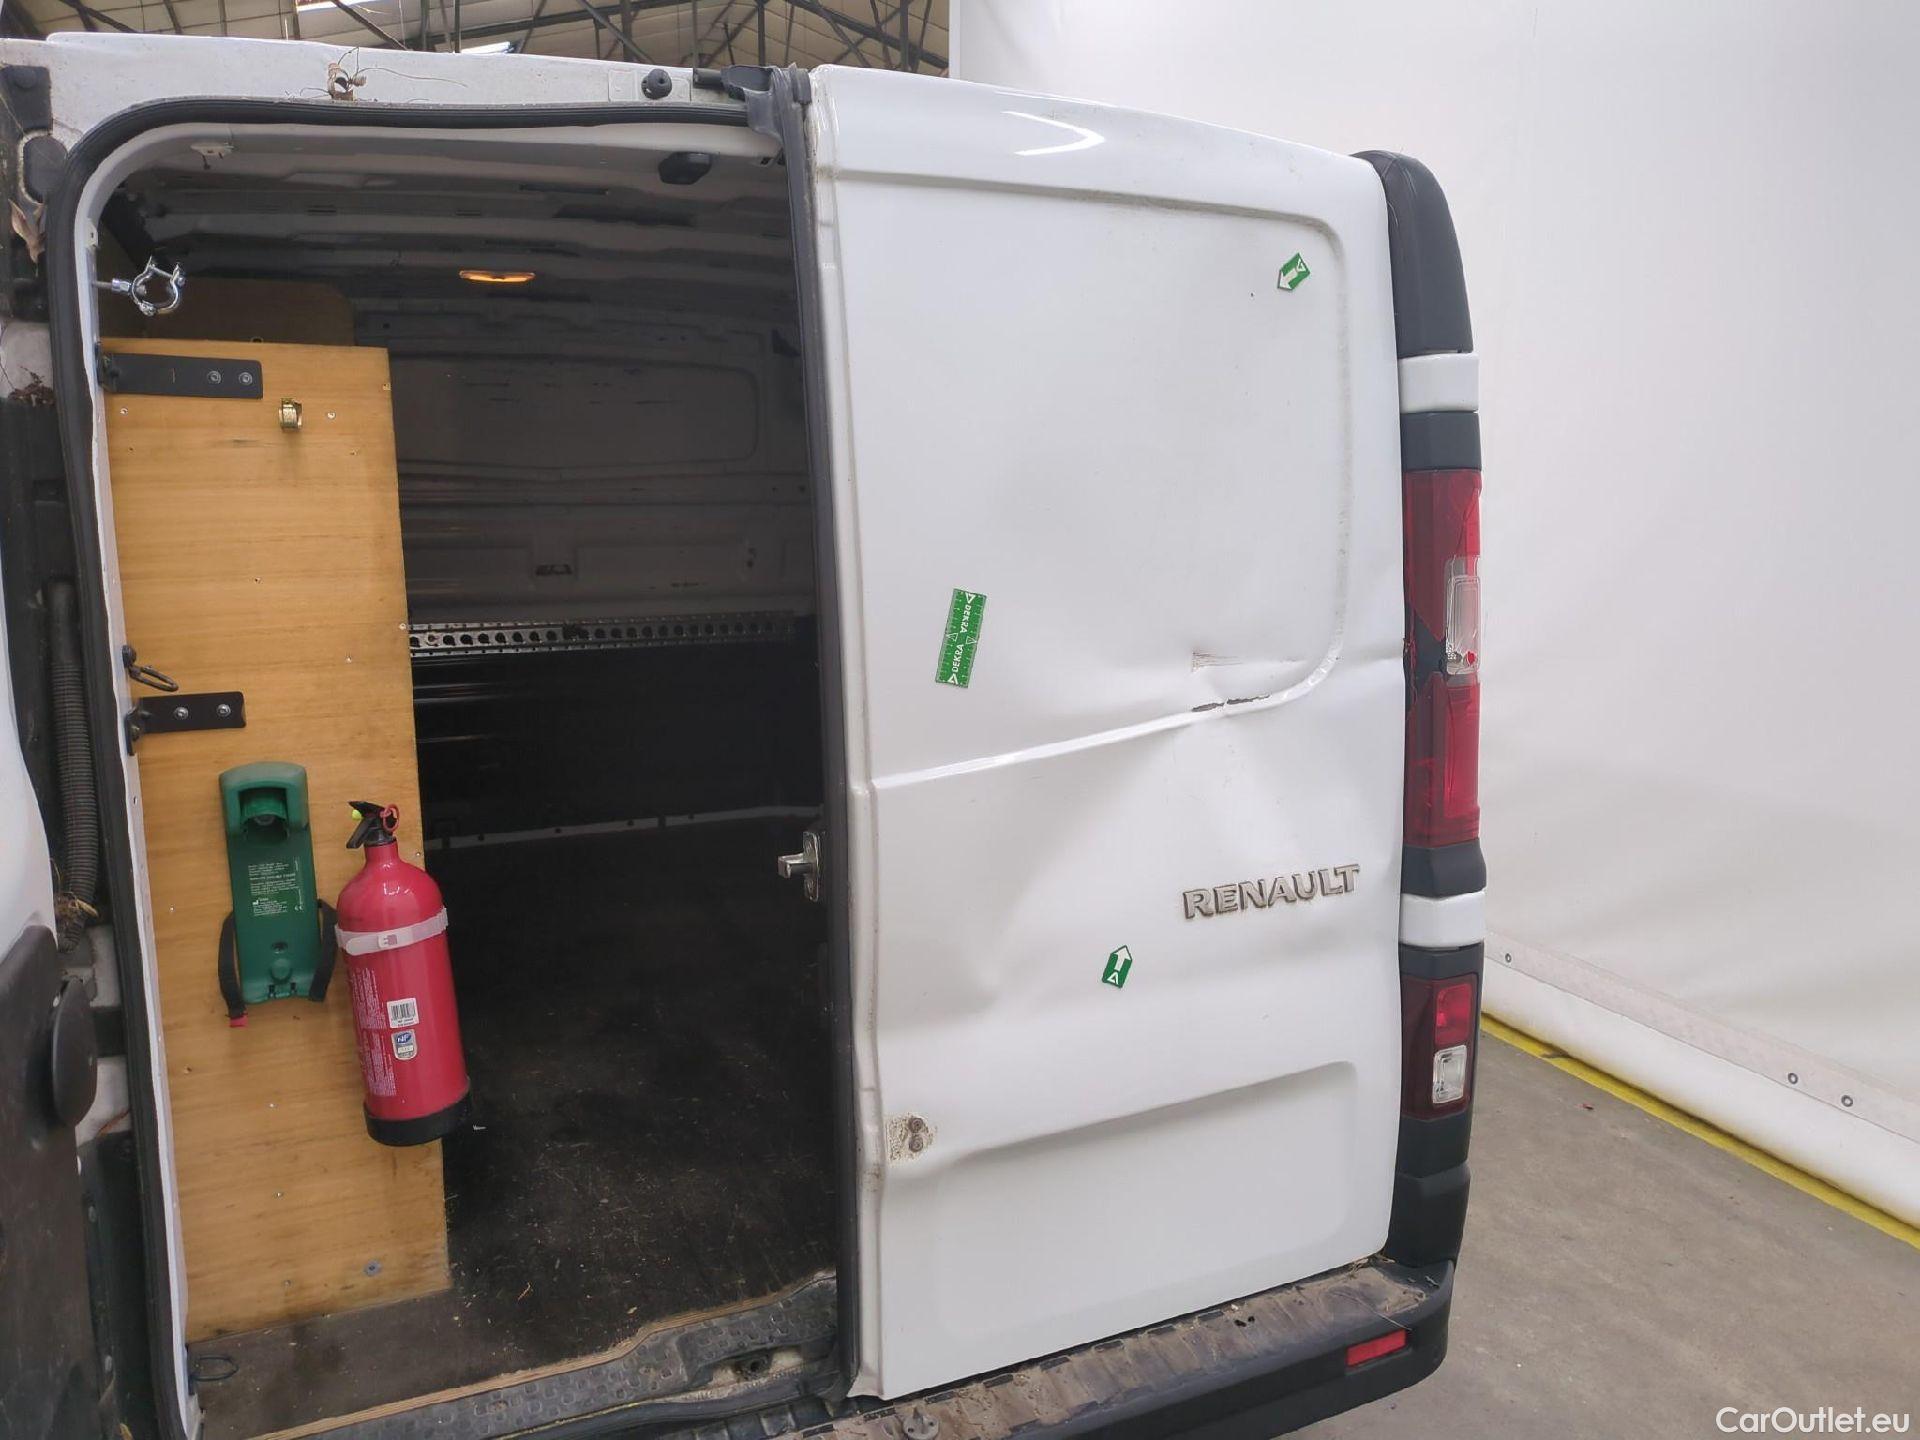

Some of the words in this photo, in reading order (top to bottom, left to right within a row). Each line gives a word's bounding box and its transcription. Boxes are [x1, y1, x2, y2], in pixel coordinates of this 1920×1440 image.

[960, 604, 972, 633] DEKRA
[951, 644, 964, 673] DEKRA
[1182, 864, 1361, 919] RENAULT
